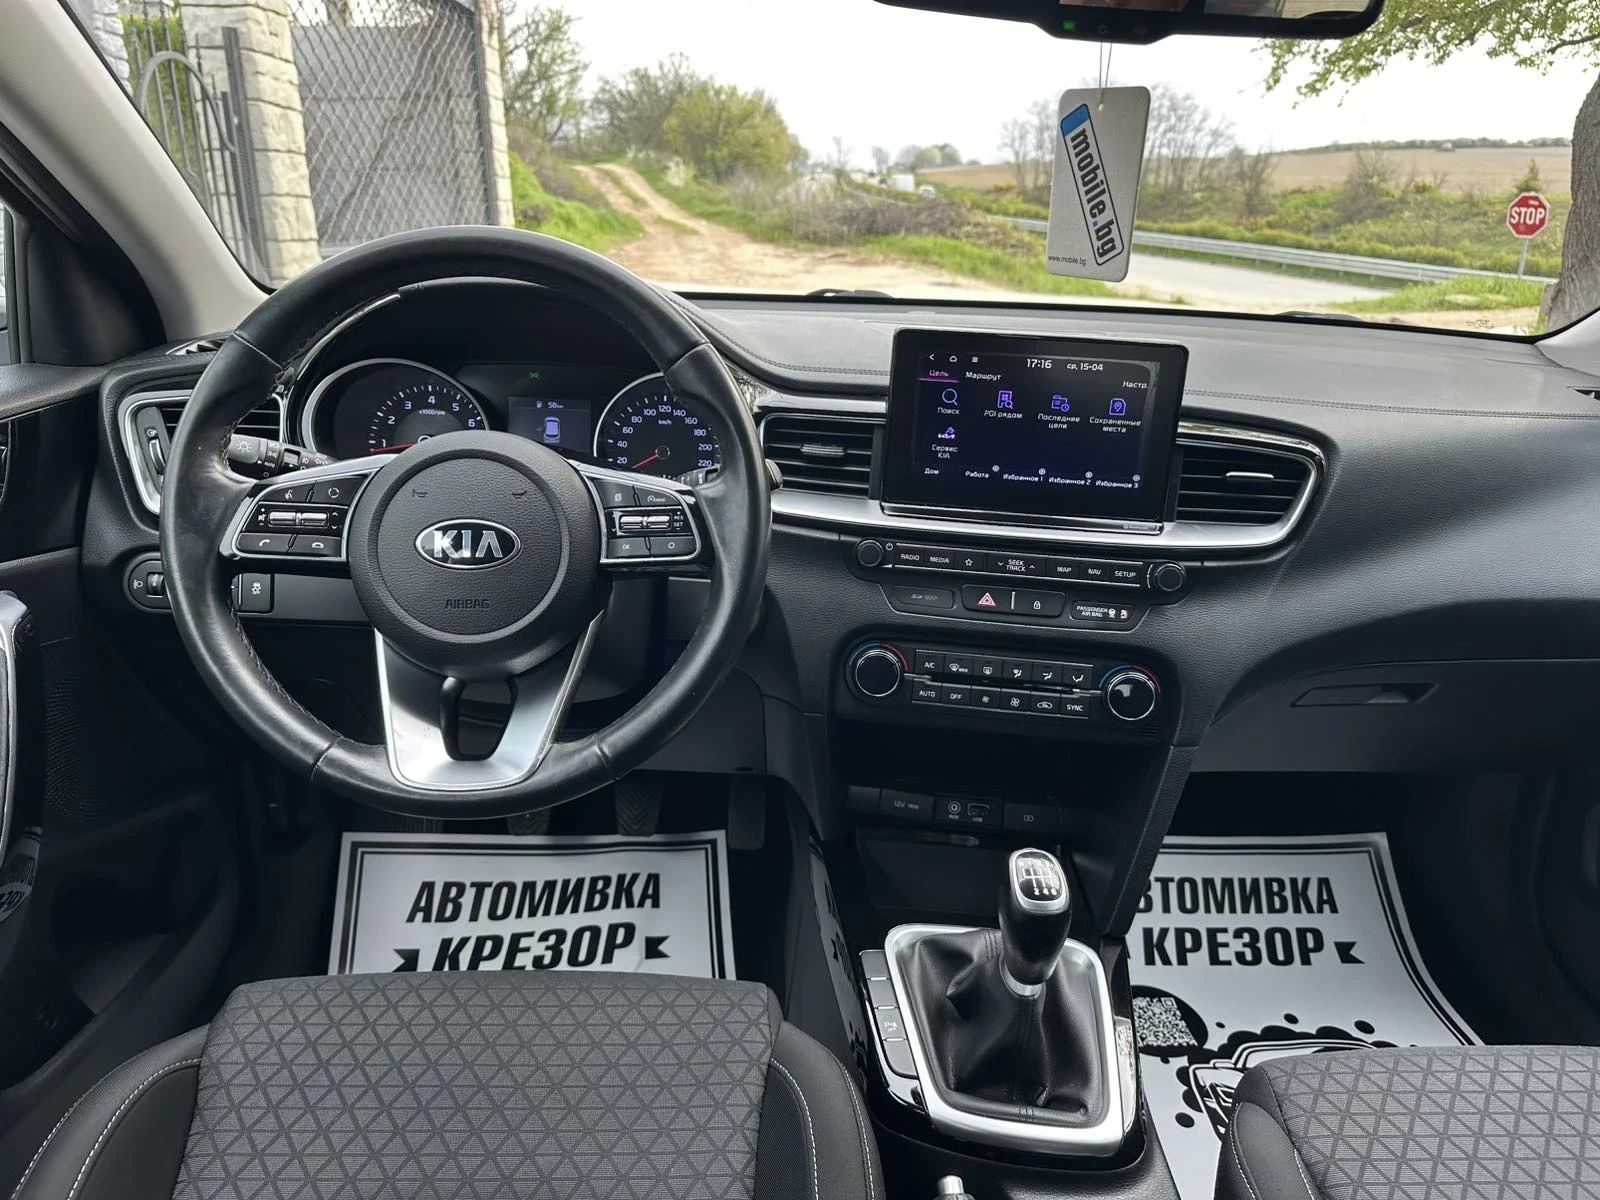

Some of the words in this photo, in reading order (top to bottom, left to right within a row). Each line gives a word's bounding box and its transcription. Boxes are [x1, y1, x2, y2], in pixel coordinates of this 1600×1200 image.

[1070, 127, 1117, 258] mobile.bg
[1510, 206, 1546, 225] STOP
[1048, 256, 1086, 267] www.mobile.bg
[1026, 359, 1052, 369] 17:16
[1080, 362, 1103, 371] 15-04
[929, 369, 949, 378] Цель
[966, 372, 1002, 381] Маршрут
[428, 396, 436, 404] 4
[405, 401, 411, 410] 3
[388, 416, 395, 424] 2
[468, 419, 475, 427] 6
[1038, 414, 1080, 423] Последние
[1090, 417, 1141, 426] Сохраненные
[932, 444, 958, 452] Сервис
[1049, 477, 1085, 485] Избранное
[433, 530, 503, 558] KIA
[444, 599, 490, 609] AIRBAG
[406, 872, 660, 923] АВТОМИВКА
[1136, 876, 1339, 914] ВТОМИВКА
[431, 922, 637, 972] КРЕЗОР
[1143, 926, 1324, 966] КРЕЗОР
